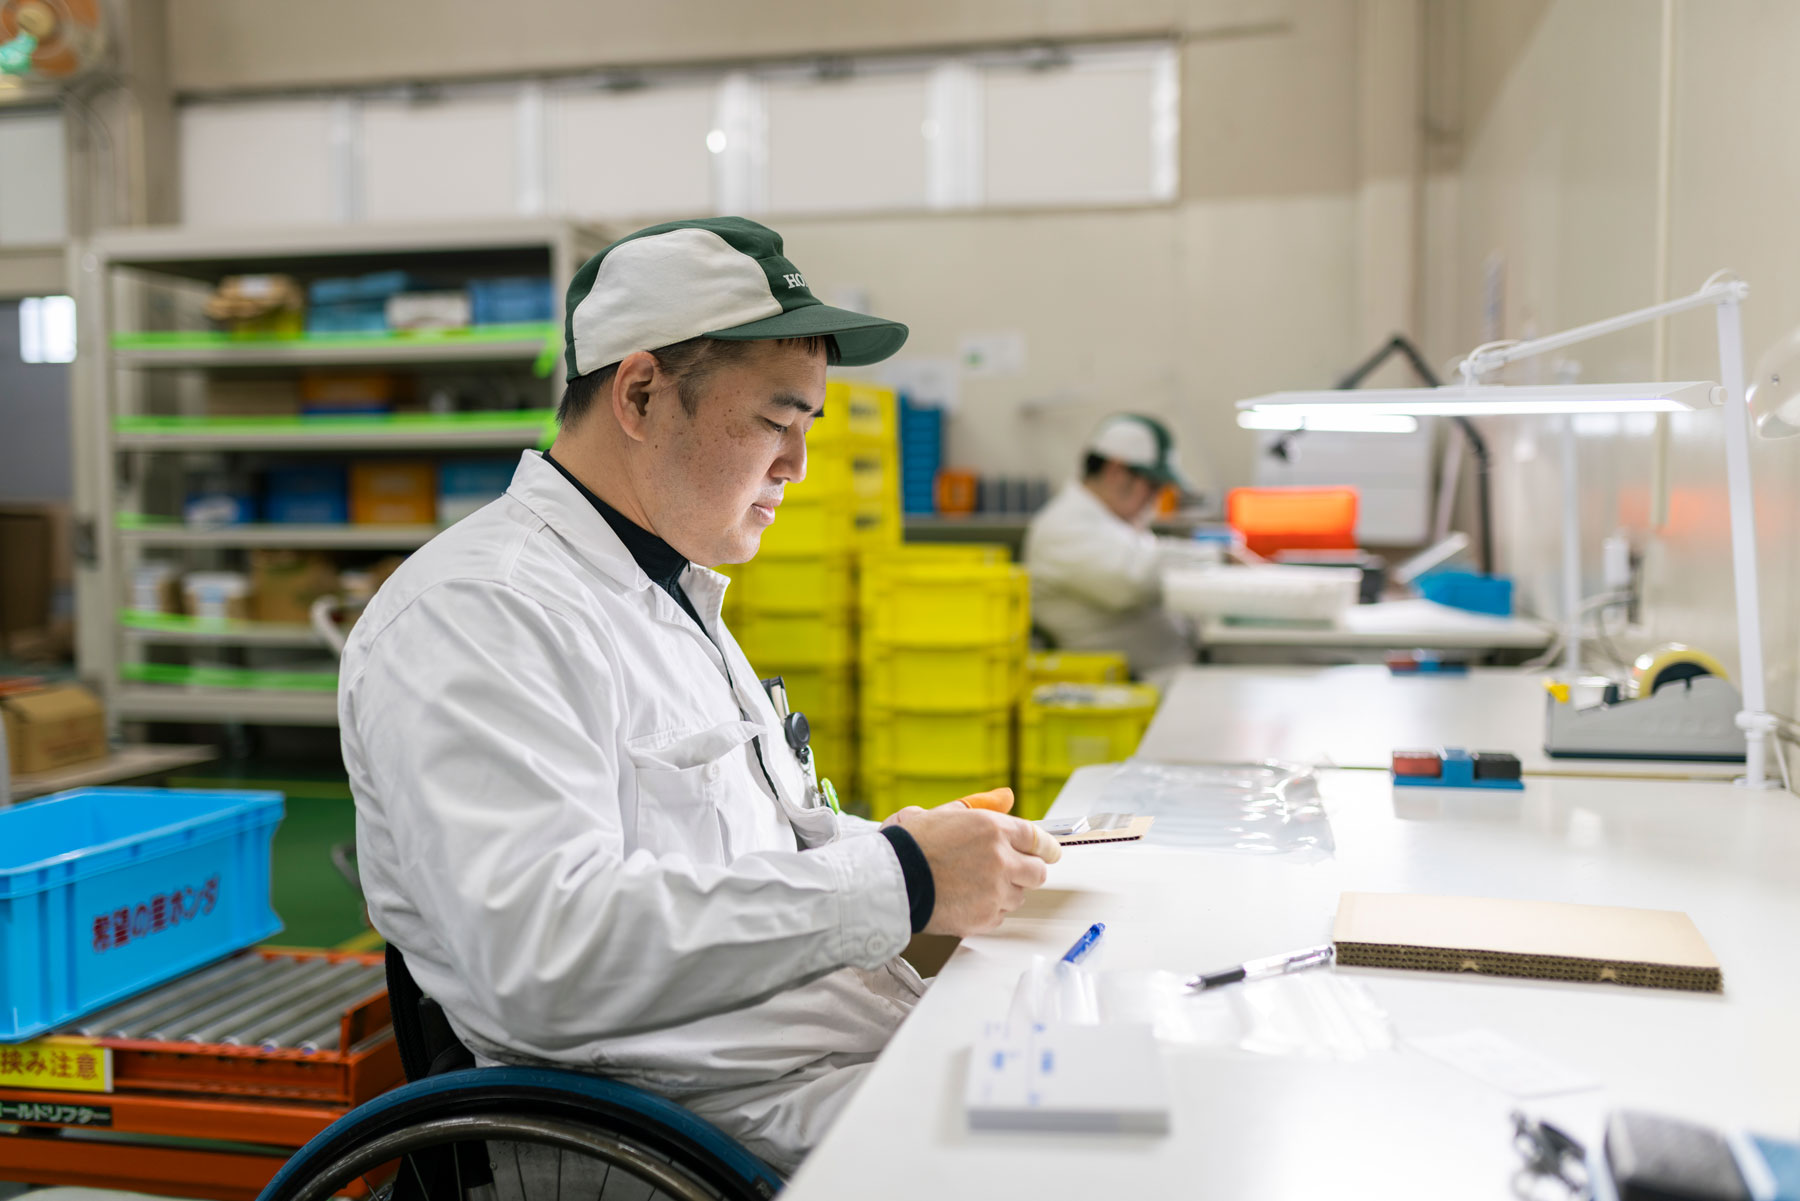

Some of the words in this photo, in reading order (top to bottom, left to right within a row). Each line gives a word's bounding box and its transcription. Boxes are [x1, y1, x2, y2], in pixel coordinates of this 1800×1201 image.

[783, 273, 808, 288] HO
[93, 874, 220, 953] 希望の里ホンダ
[0, 1102, 111, 1124] ールドリフター
